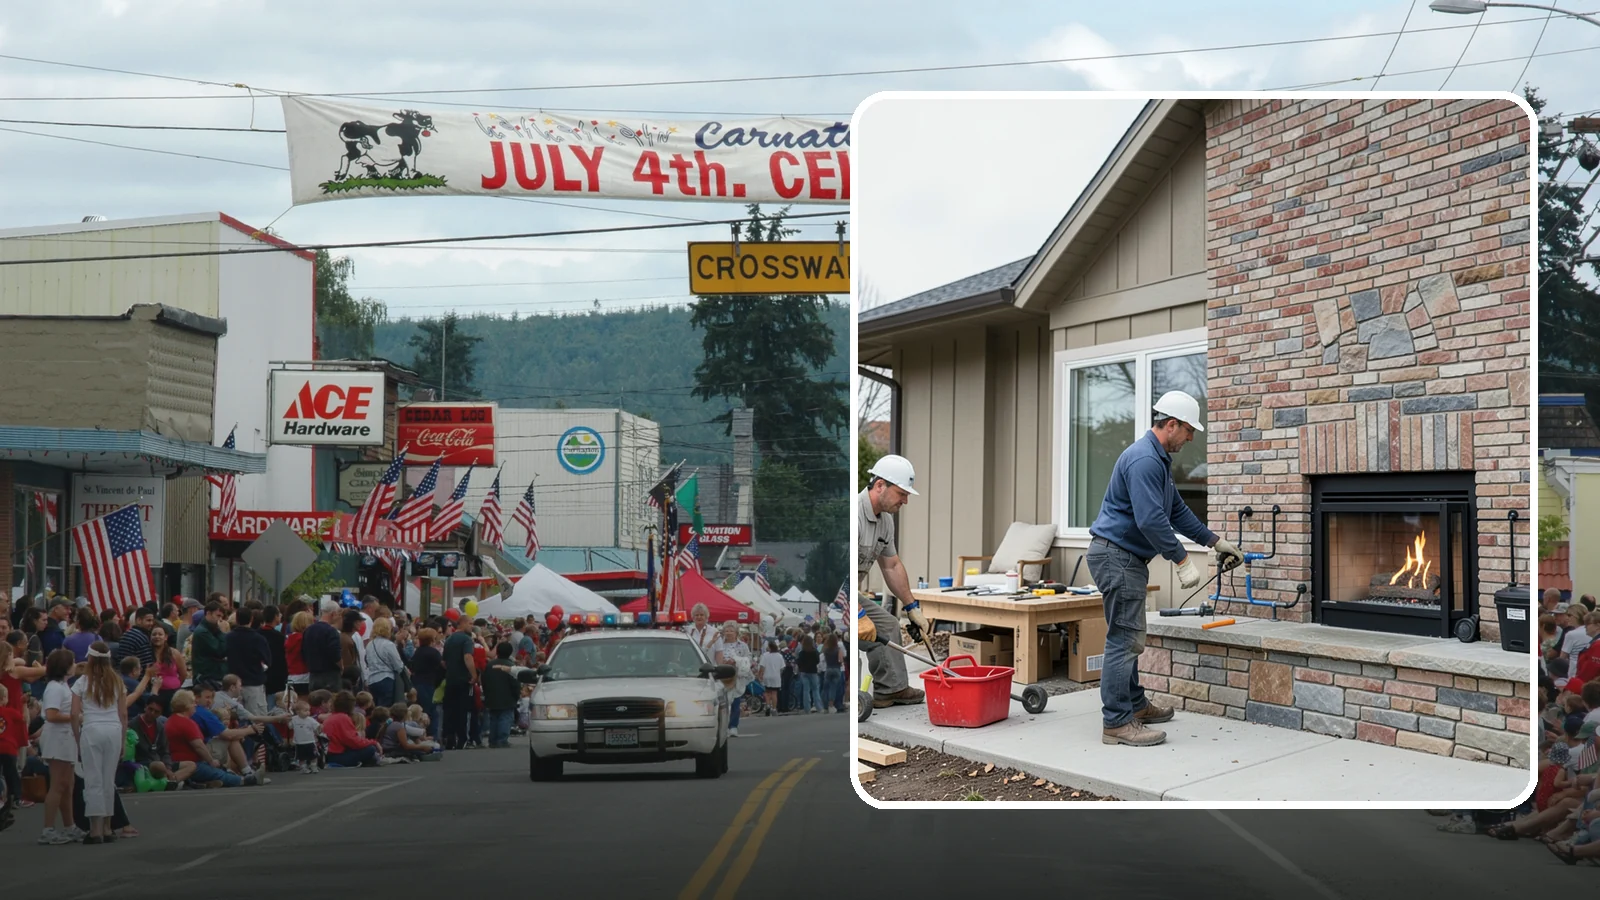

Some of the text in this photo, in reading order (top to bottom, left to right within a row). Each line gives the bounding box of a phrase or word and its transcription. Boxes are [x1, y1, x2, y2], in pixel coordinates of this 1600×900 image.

[694, 121, 850, 150] Carnat
[481, 141, 605, 192] JULY
[632, 150, 746, 198] 4th.
[697, 254, 850, 280] CROSSWA
[282, 380, 373, 420] ACE
[405, 409, 485, 422] CEDAR LOG
[283, 421, 371, 437] Hardware
[416, 428, 477, 447] Coca-Cola
[83, 485, 155, 495] St. Vincent de Paul
[688, 526, 741, 535] CRNATION
[699, 535, 730, 543] GLASS
